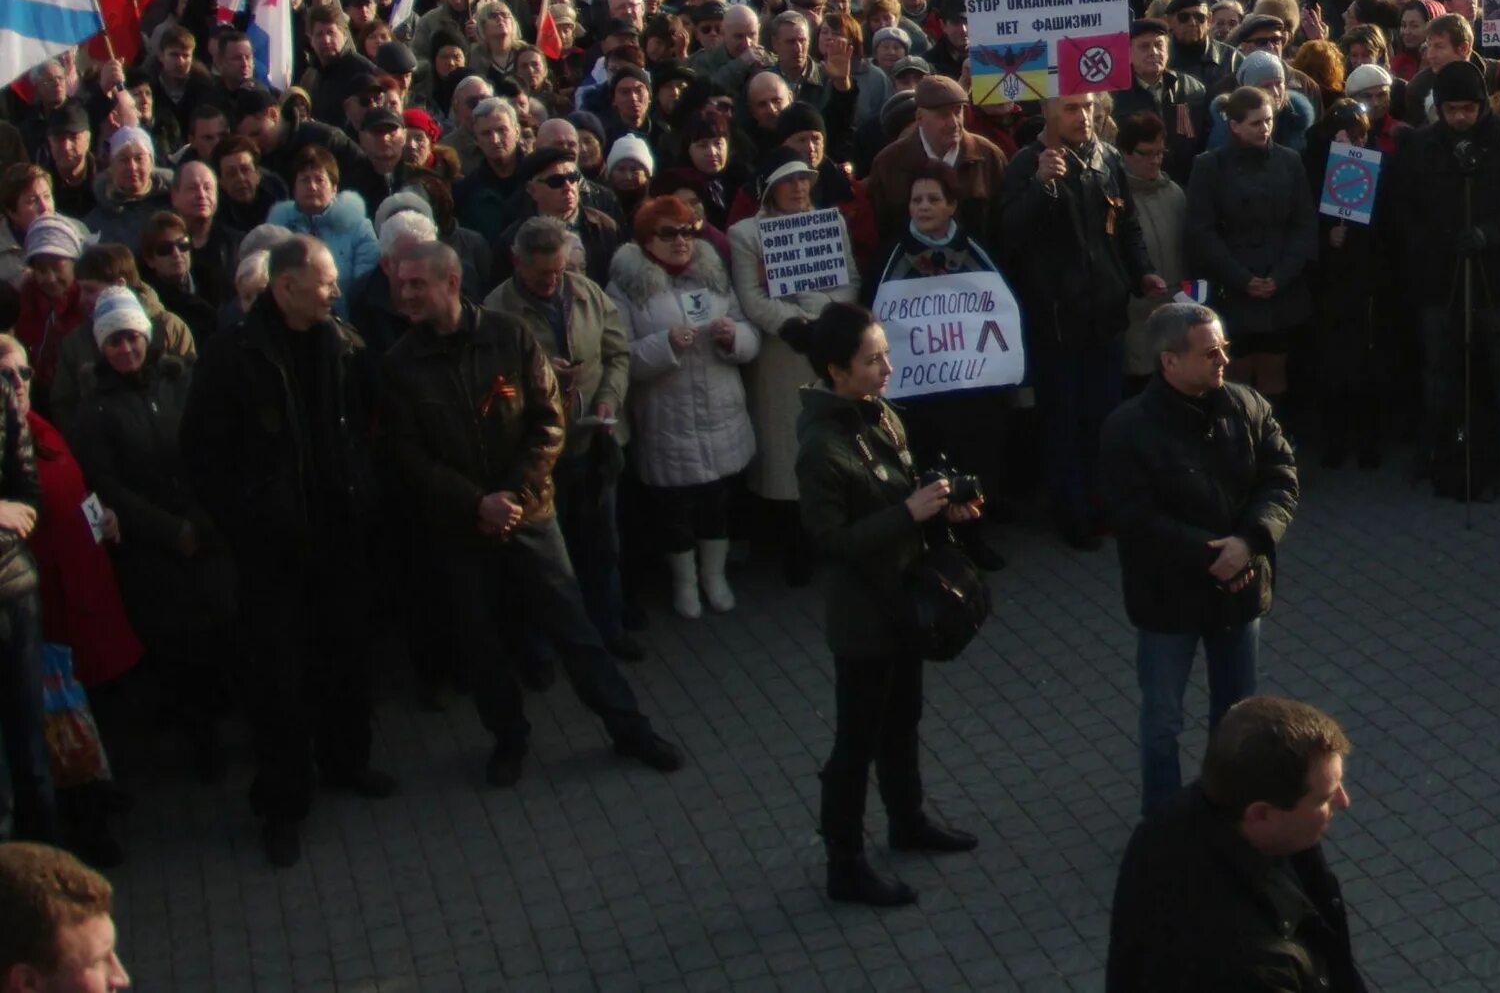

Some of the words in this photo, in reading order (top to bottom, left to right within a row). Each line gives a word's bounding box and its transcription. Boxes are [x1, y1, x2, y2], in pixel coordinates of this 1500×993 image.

[996, 20, 1019, 35] НЕТ
[1032, 13, 1102, 32] ФАШИЗМУ!
[1483, 21, 1496, 32] ЗА
[1483, 33, 1500, 43] ЗА
[1348, 149, 1363, 159] NO
[760, 210, 838, 233] ЧЕРНОМОРСКИЙ
[1338, 207, 1352, 217] EU
[764, 234, 794, 248] ФЛОТ
[798, 226, 840, 243] РОССИИ
[765, 249, 801, 264] ГАРАНТ
[805, 244, 833, 258] МИРА
[836, 243, 843, 253] И
[767, 257, 845, 280] СТАБИЛЬНОСТИ
[780, 283, 788, 295] В
[794, 274, 838, 292] КРЫМУ!
[910, 321, 965, 356] СЫН
